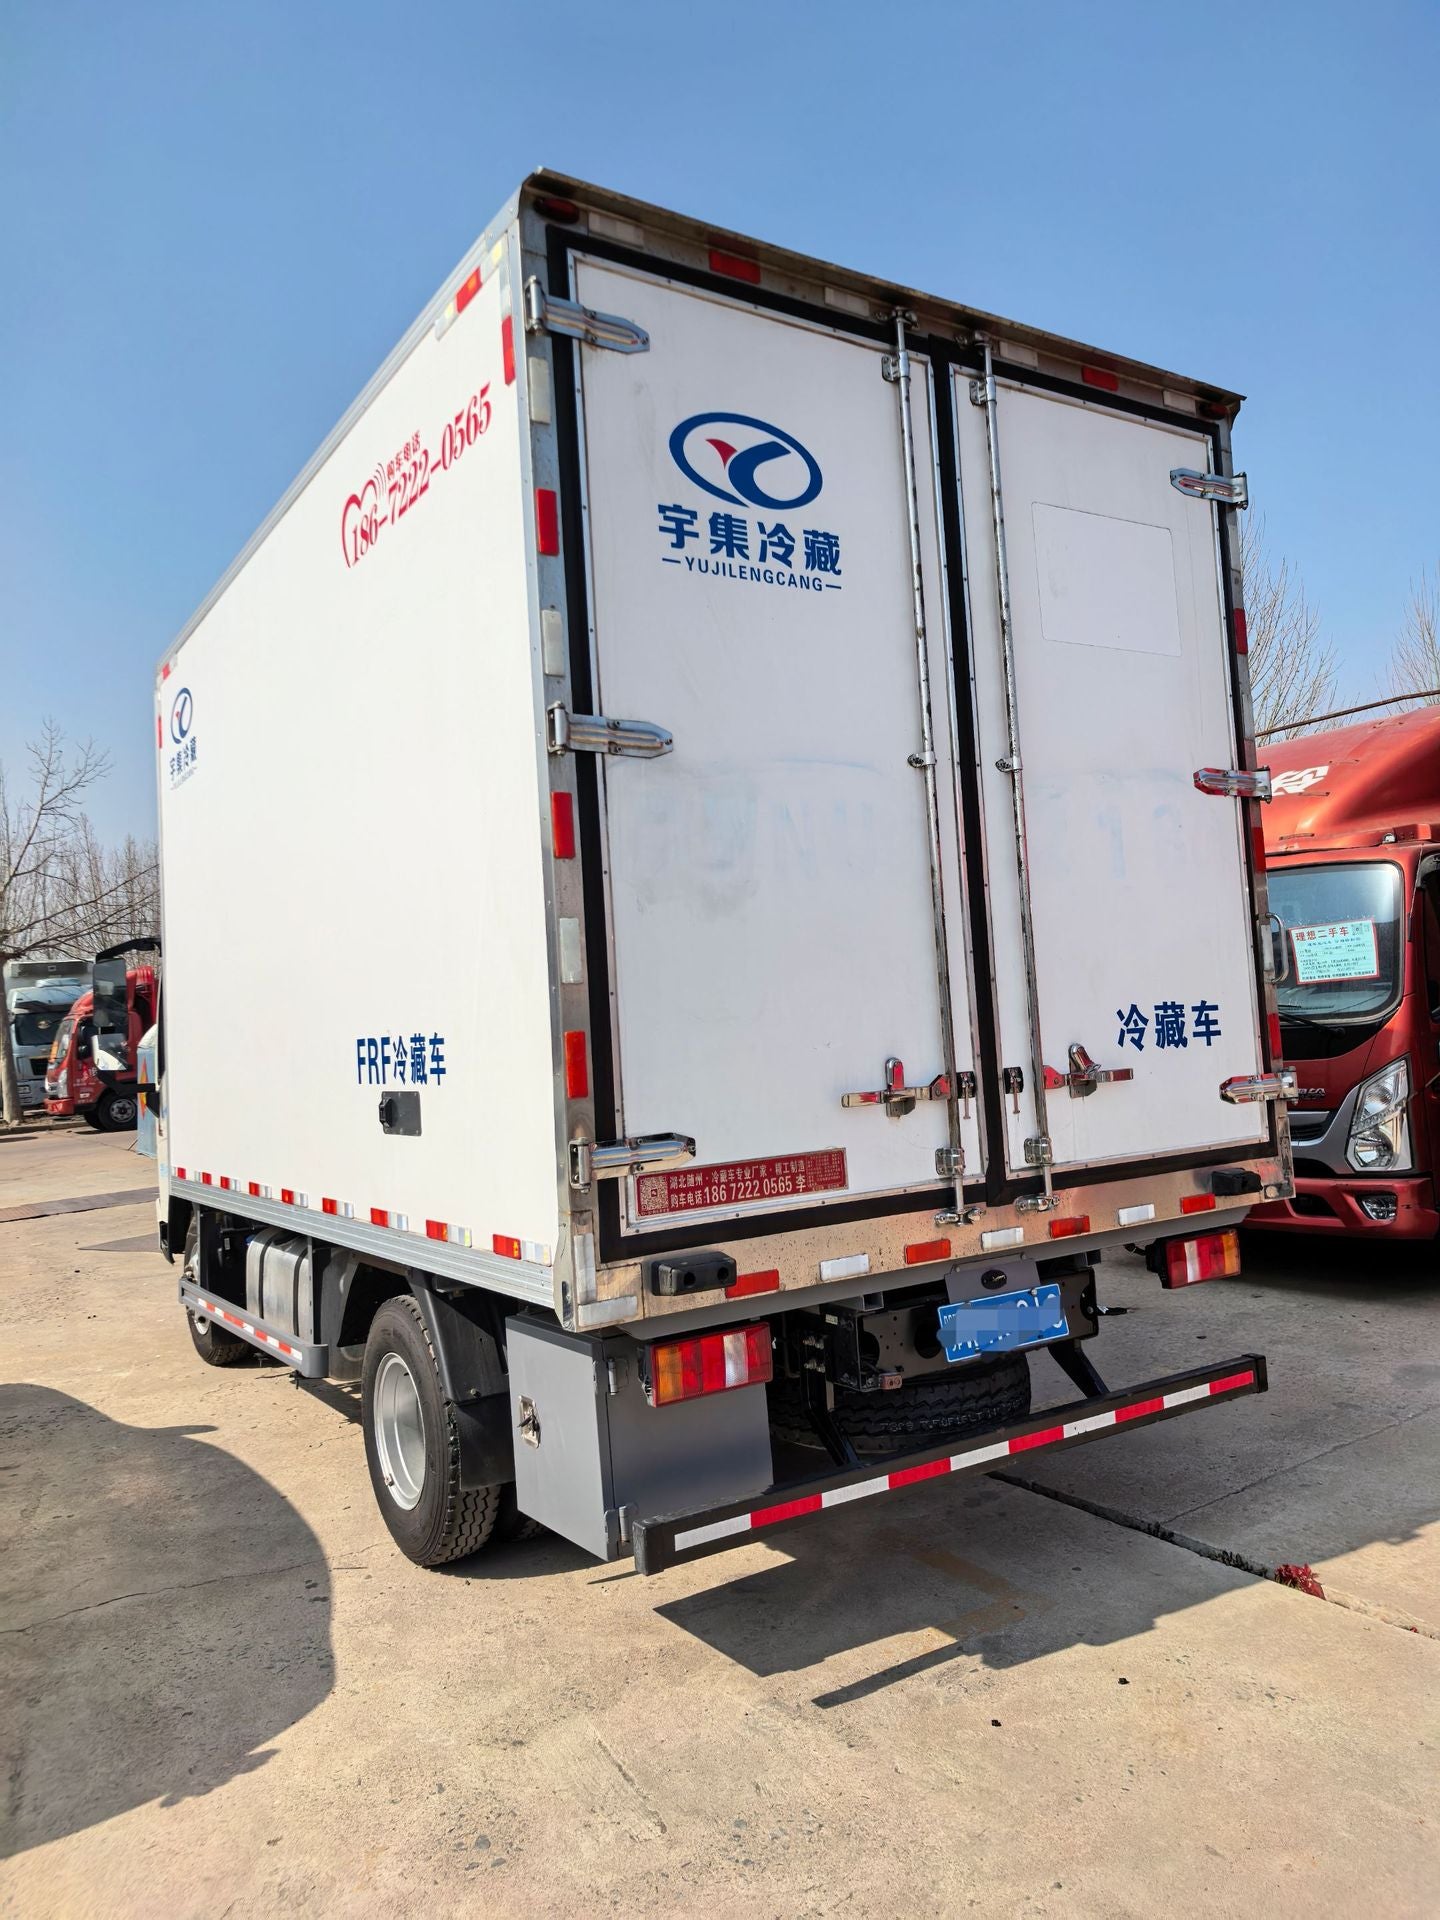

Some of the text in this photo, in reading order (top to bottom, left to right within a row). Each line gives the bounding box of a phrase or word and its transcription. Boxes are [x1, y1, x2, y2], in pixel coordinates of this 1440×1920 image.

[352, 381, 492, 566] 186-7222-0565
[657, 503, 842, 576] 宇集冷藏
[684, 555, 823, 592] YUJILENGCANG
[1295, 926, 1349, 941] 理想二手车
[1116, 999, 1222, 1052] 冷藏车
[356, 1031, 447, 1086] FRF冷藏车
